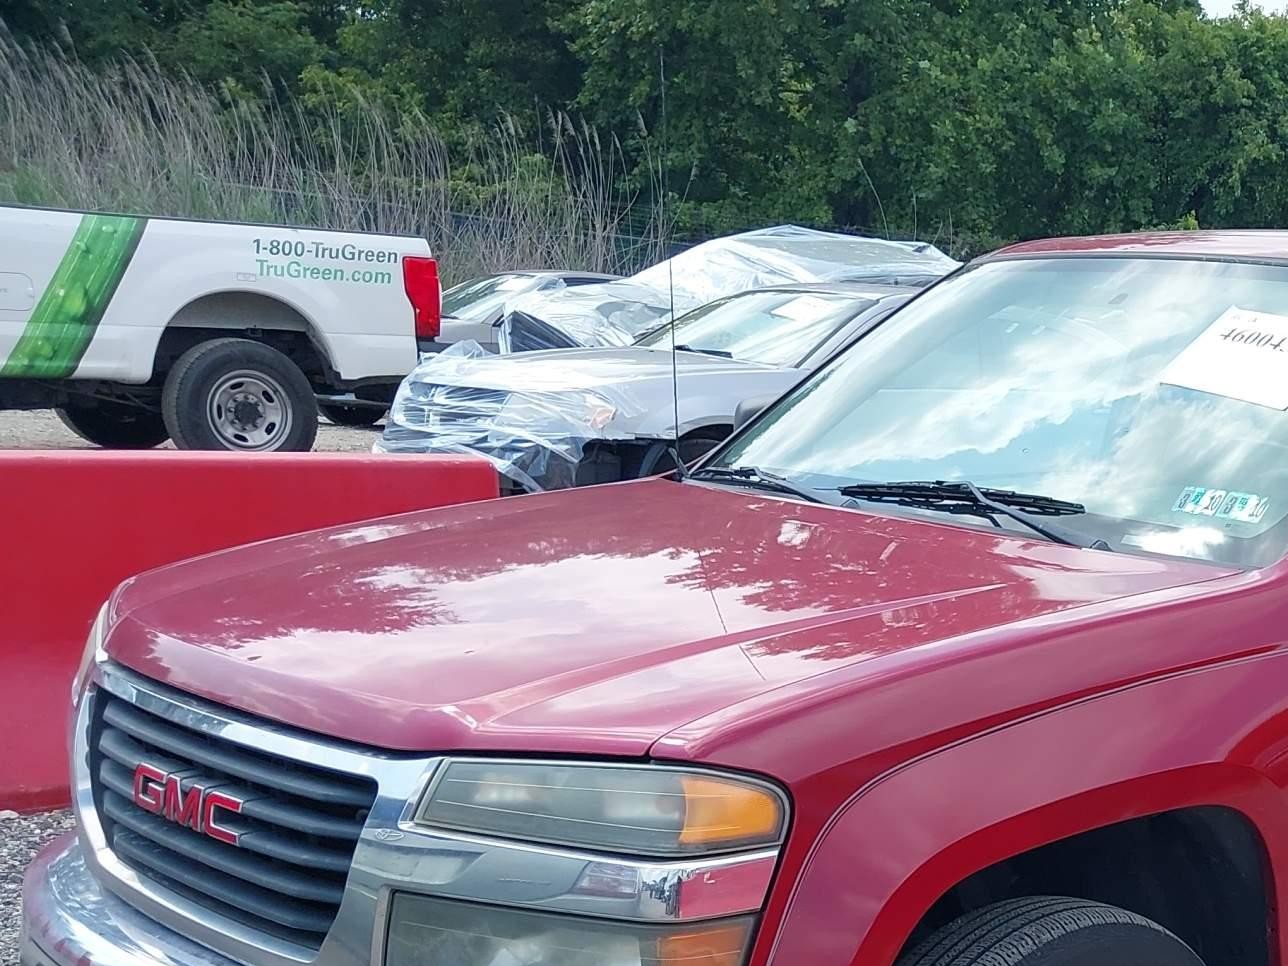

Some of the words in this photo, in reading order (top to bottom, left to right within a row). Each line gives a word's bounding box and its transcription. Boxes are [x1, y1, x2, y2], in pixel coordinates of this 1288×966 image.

[252, 238, 398, 264] 1-800-TruGreen
[256, 259, 392, 284] TruGreen.com
[133, 762, 244, 846] GMC
